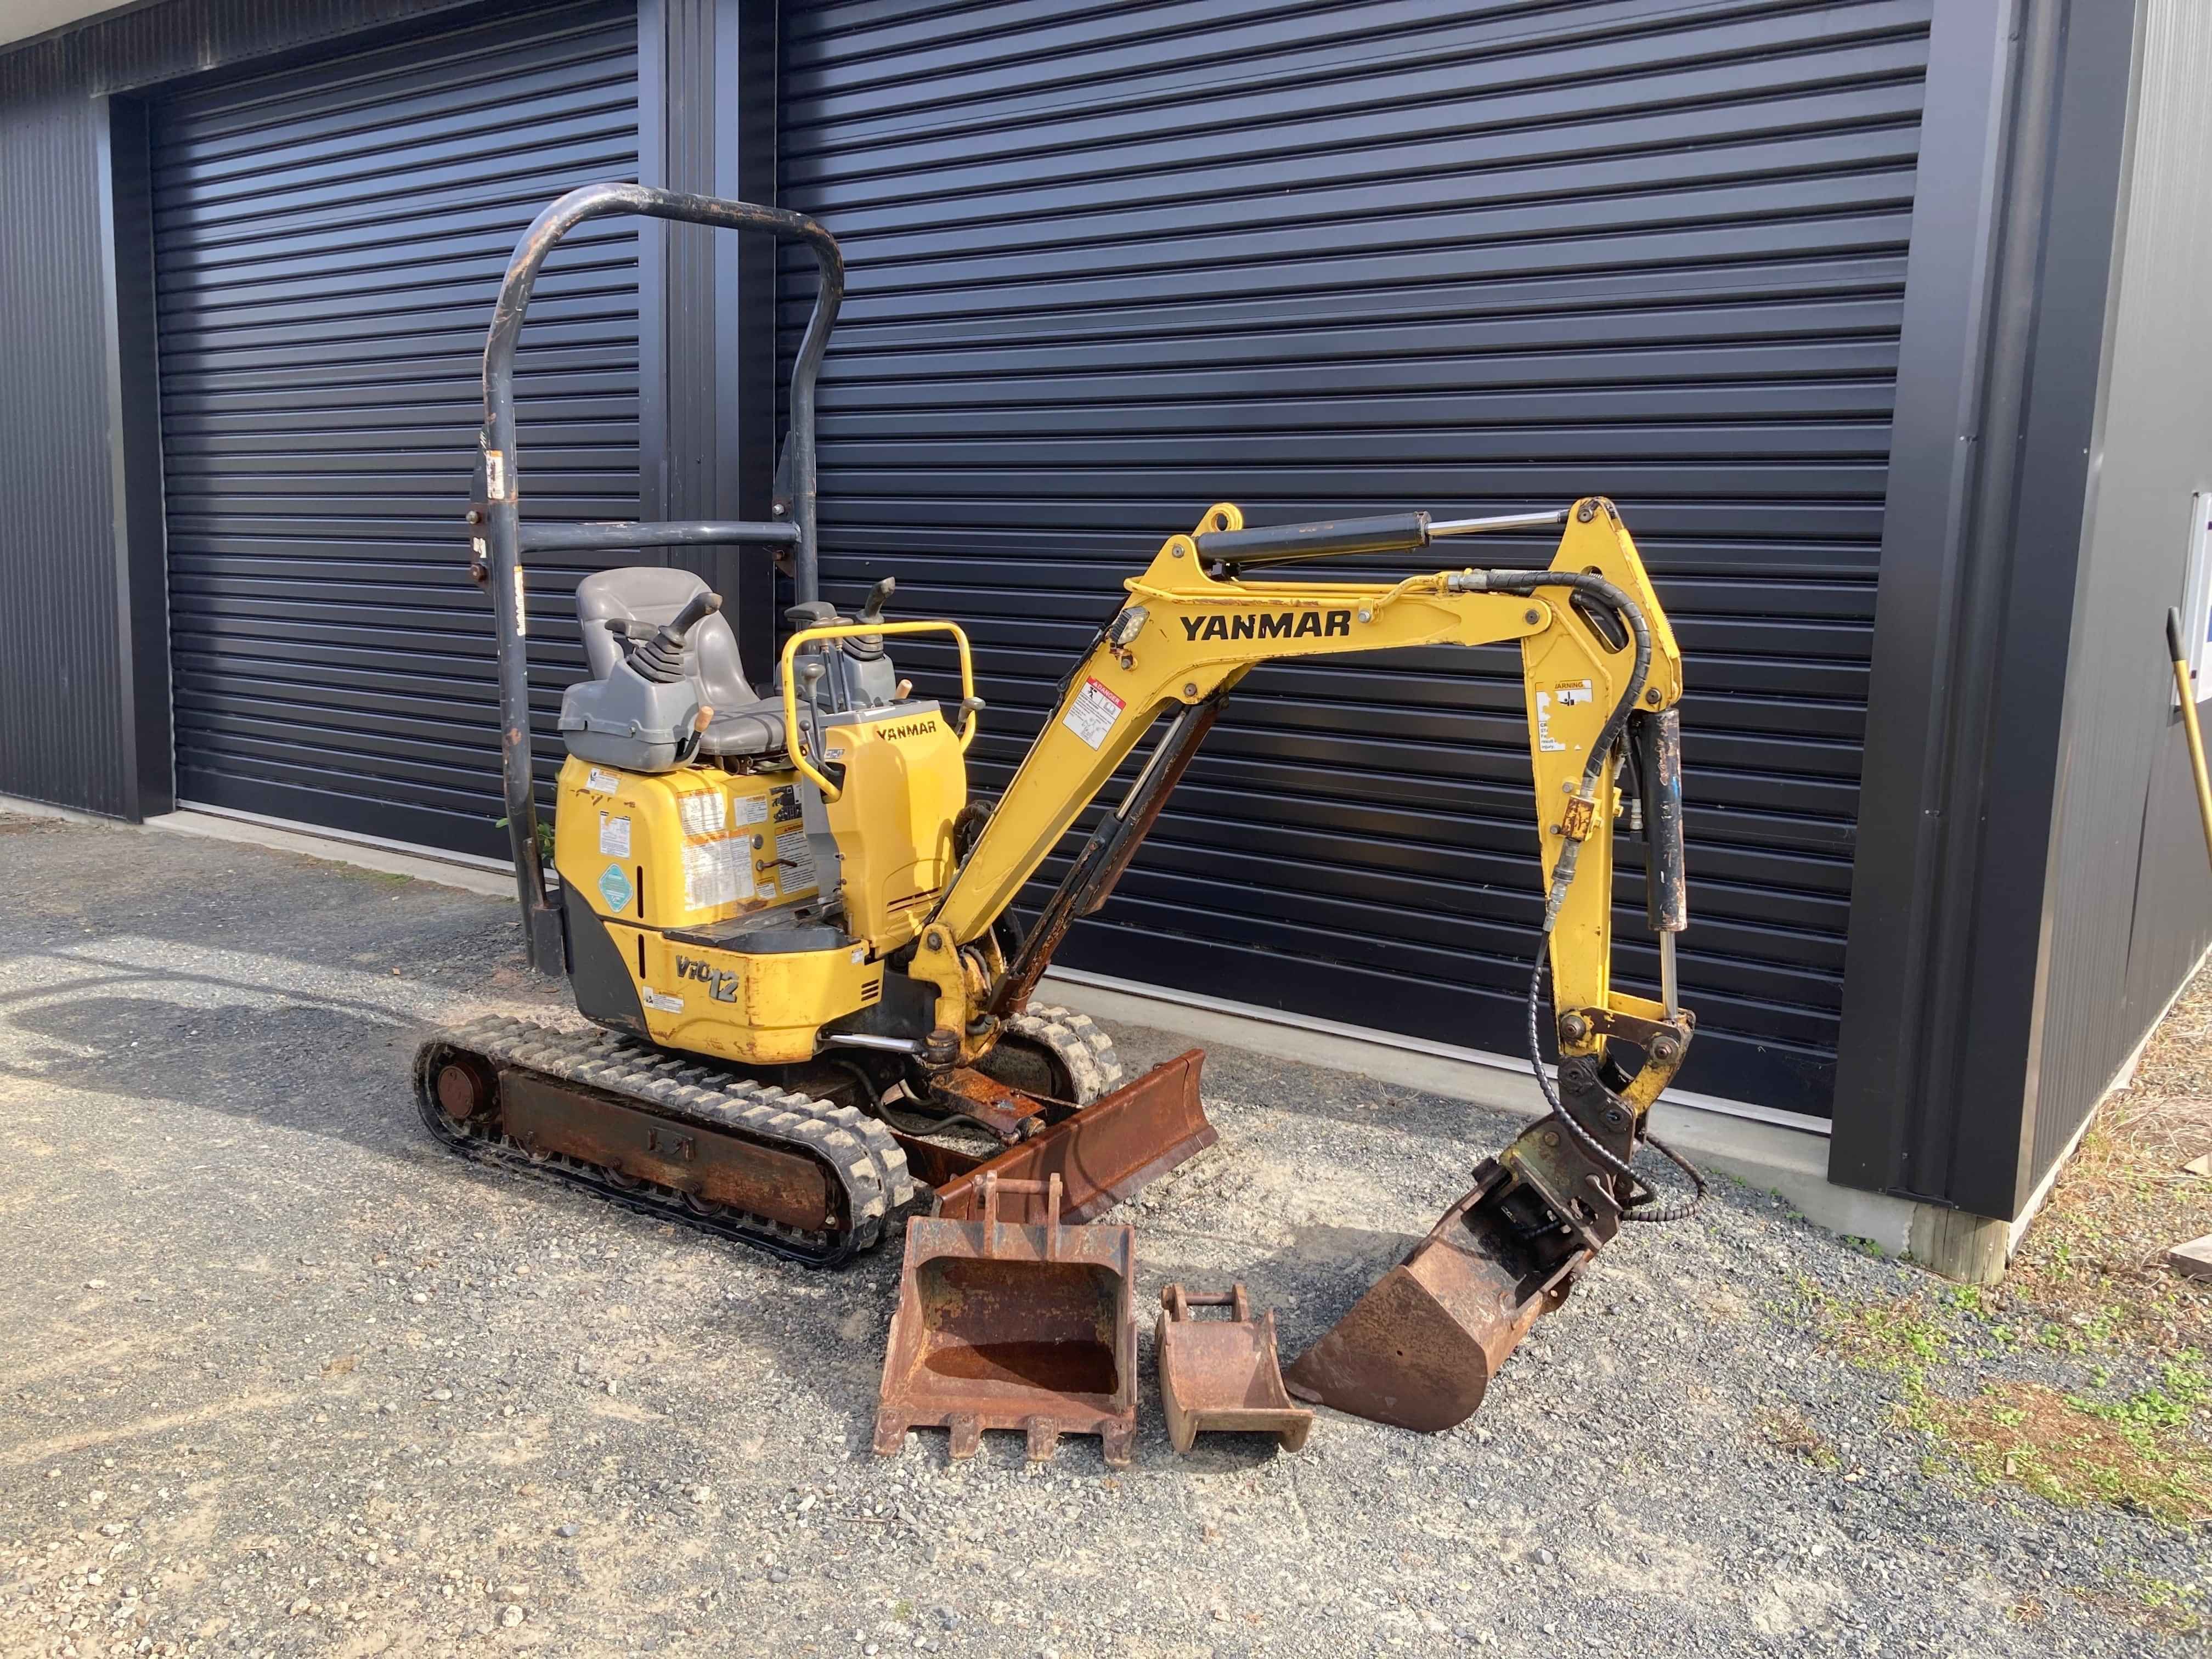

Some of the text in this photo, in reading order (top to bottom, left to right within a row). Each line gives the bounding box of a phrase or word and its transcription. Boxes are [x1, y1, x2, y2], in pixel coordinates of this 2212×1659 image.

[1180, 610, 1351, 641] YANMAR
[1097, 683, 1120, 704] DANGER
[876, 720, 936, 741] YANMAR
